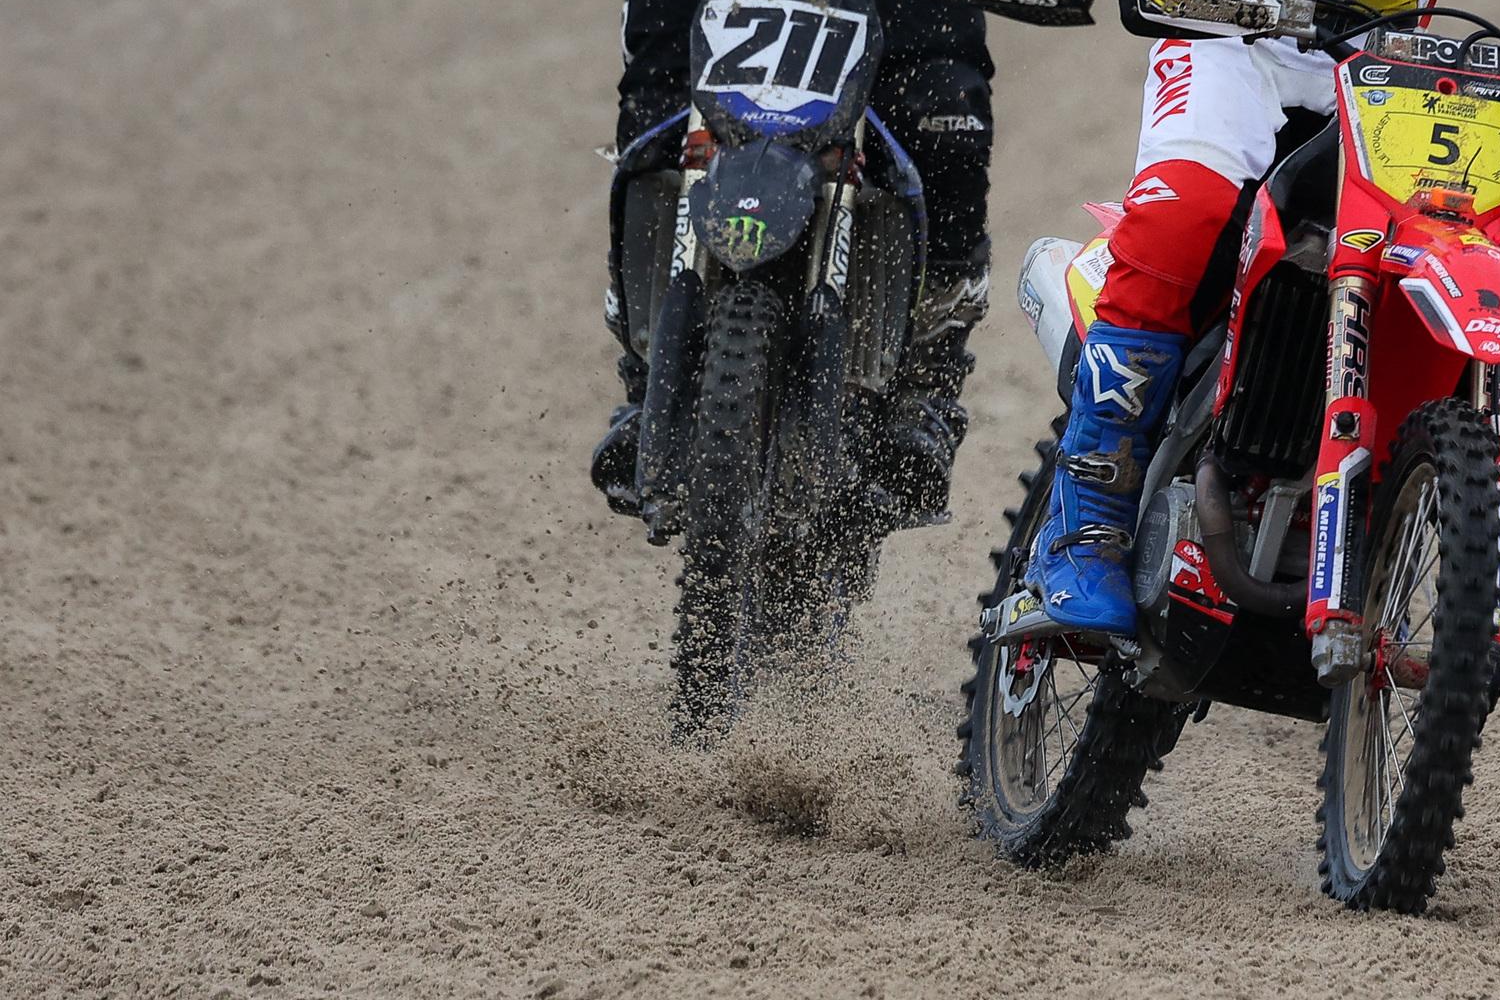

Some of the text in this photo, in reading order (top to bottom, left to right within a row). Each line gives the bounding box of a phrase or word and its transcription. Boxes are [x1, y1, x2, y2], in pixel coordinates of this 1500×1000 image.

[705, 7, 860, 97] 211
[1372, 114, 1392, 164] LE TOUQUET
[1428, 122, 1461, 165] 5
[1441, 275, 1463, 298] BIKE
[1314, 510, 1330, 590] MICHELIN
